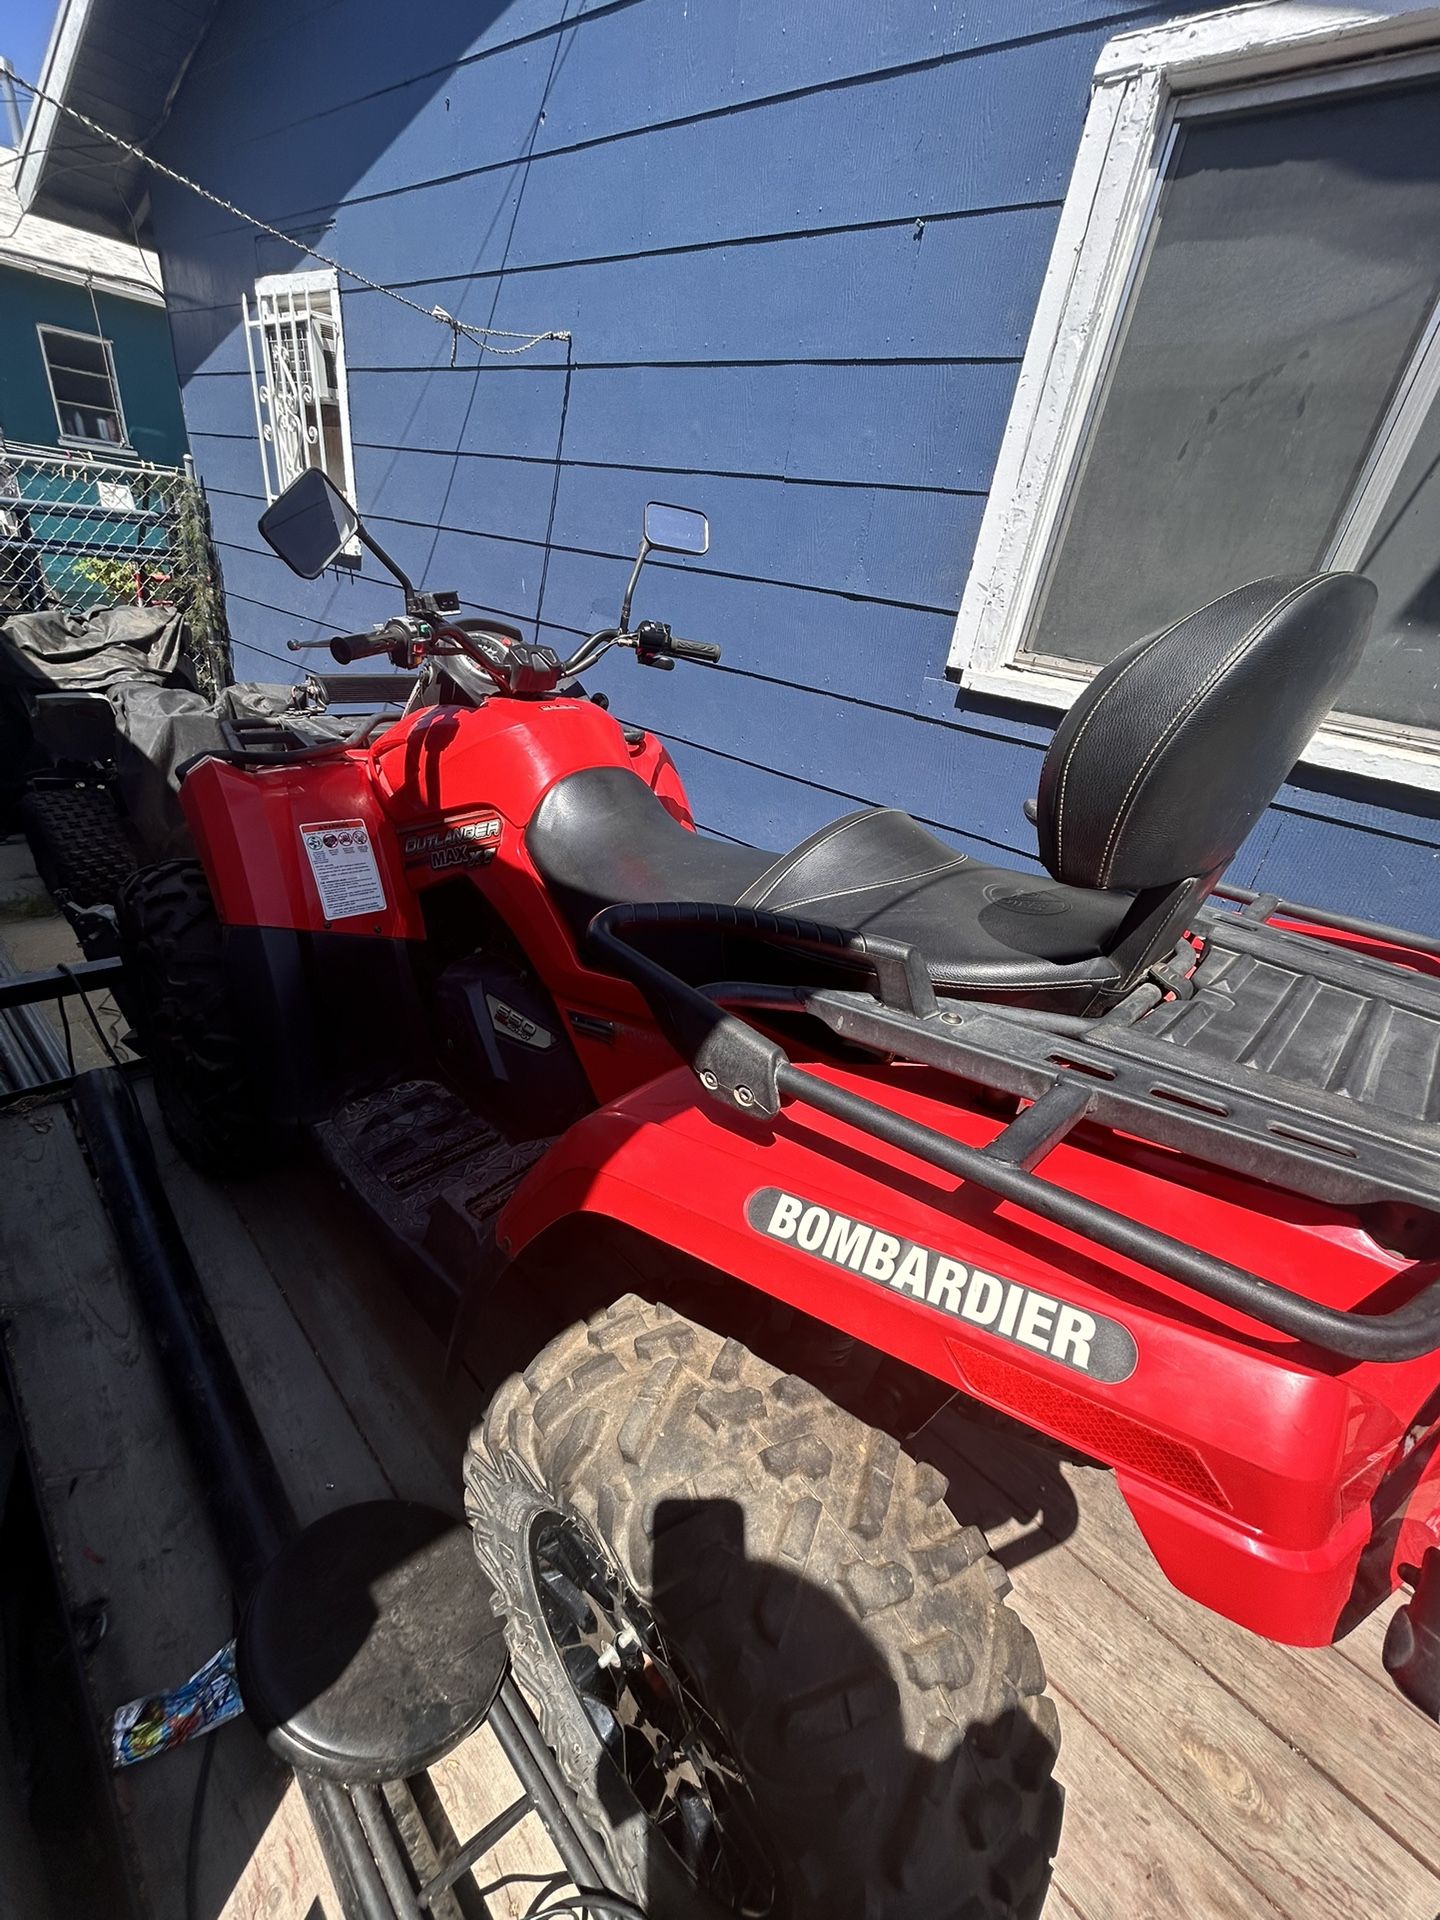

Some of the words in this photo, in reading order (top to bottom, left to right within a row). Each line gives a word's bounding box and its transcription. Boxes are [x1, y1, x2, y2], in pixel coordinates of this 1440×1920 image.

[405, 819, 501, 854] OUTLANDER
[431, 845, 469, 869] MAX
[767, 1193, 1097, 1370] BOMBARDIER
